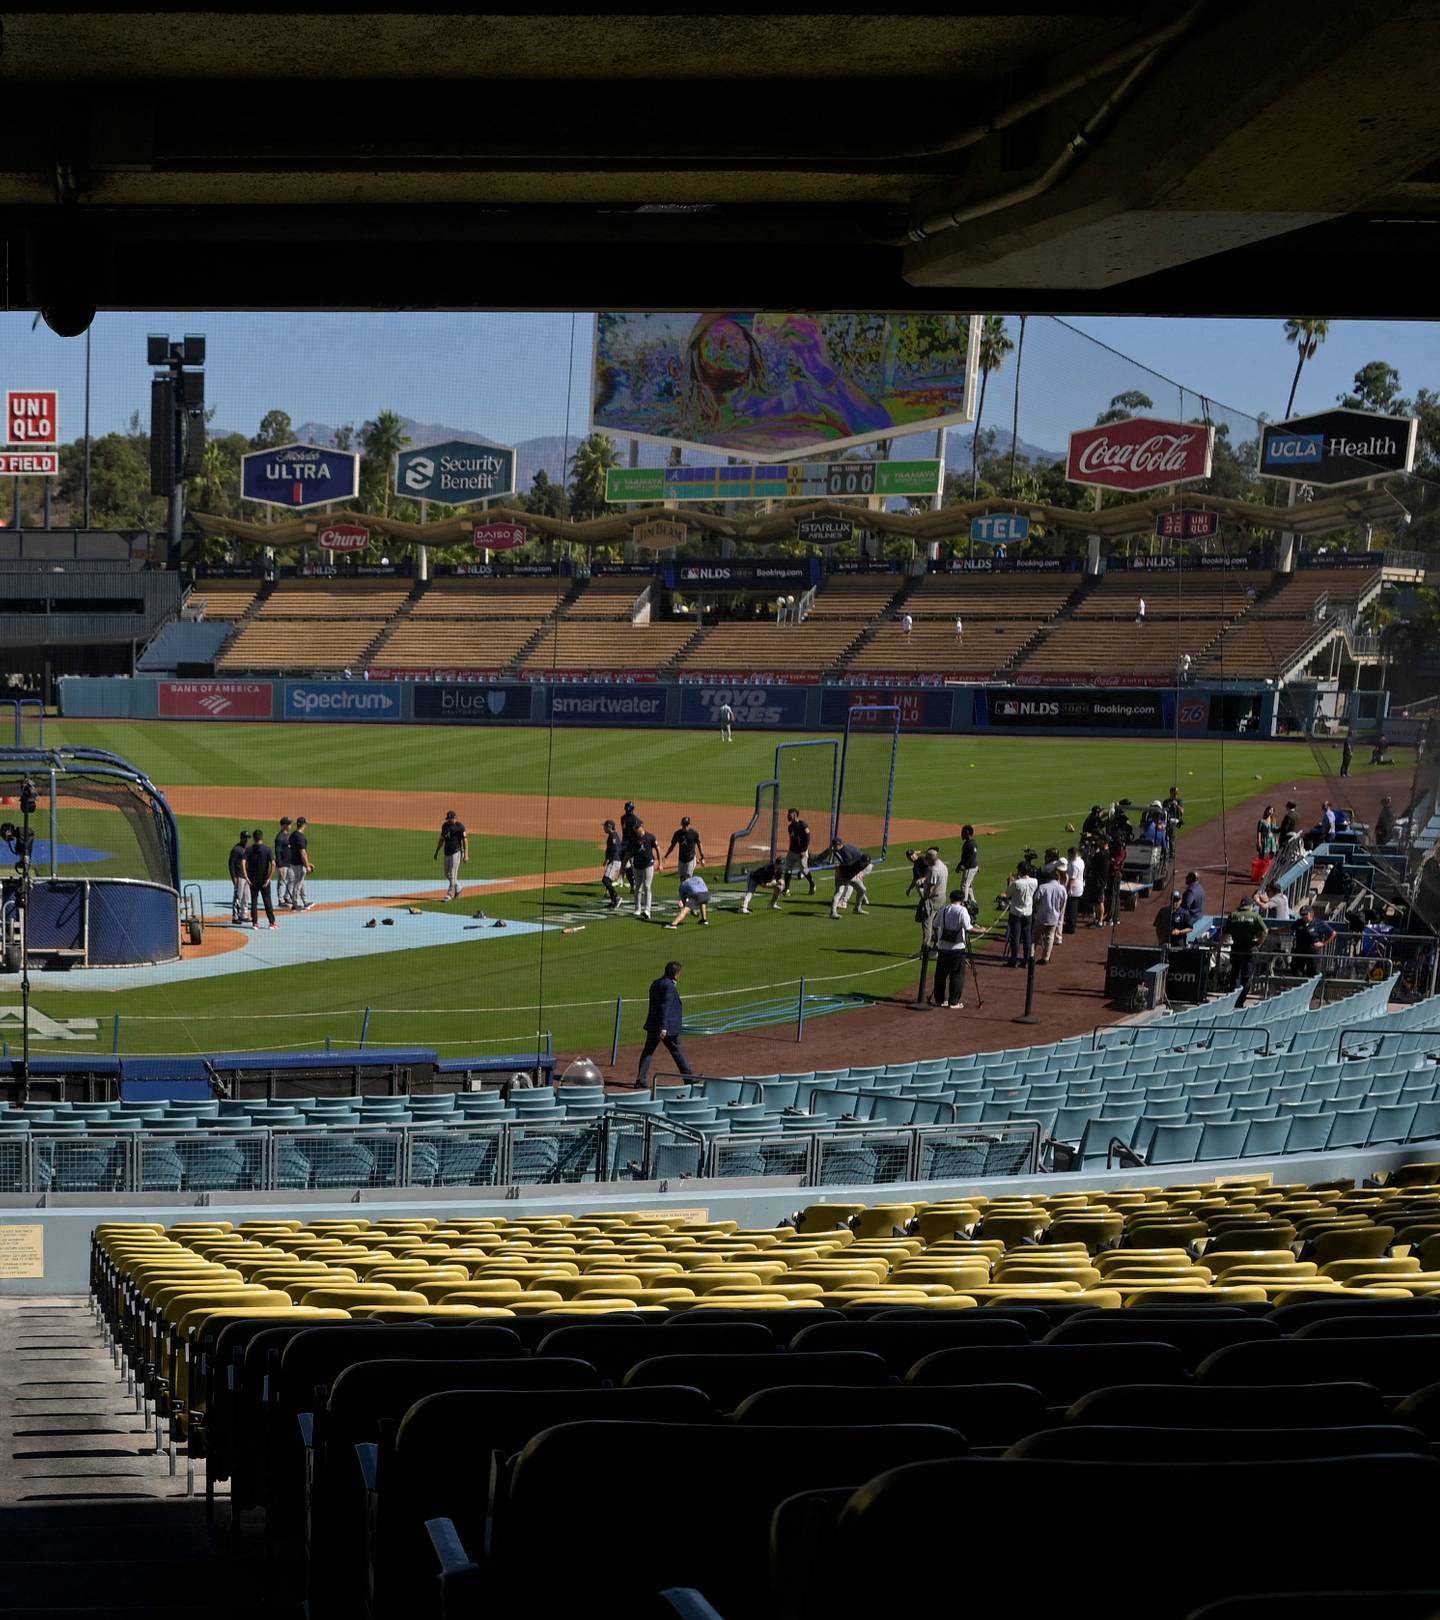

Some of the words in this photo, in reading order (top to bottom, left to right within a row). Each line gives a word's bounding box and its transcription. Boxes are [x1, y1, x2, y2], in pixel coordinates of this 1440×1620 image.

[13, 398, 48, 416] UNI
[13, 419, 51, 440] QLO
[1079, 433, 1197, 473] Coca-Cola
[1271, 441, 1316, 457] UCLA
[1328, 436, 1396, 457] Health
[9, 457, 51, 471] FIELD
[266, 464, 331, 480] ULTRA
[440, 456, 503, 474] Security
[440, 473, 494, 490] Benefit
[831, 474, 841, 493] 0
[846, 474, 856, 493] 0
[861, 473, 871, 492] 0
[801, 523, 849, 532] STARLUX
[978, 519, 1021, 538] TEL
[1192, 516, 1208, 525] UNI
[320, 530, 366, 546] Churu
[477, 530, 510, 538] DAISO
[467, 565, 492, 574] NLDS
[963, 559, 992, 569] NLDS
[1145, 557, 1176, 567] NLDS
[313, 566, 337, 575] NLDS
[700, 568, 730, 578] NLDS
[757, 568, 802, 577] Booking.com
[171, 685, 198, 693] BANK
[200, 685, 213, 693] OF
[215, 685, 260, 693] AMERICA
[293, 689, 387, 712] Spectrum
[442, 690, 485, 709] blue
[553, 696, 659, 713] smartwater
[700, 689, 767, 706] TOYO
[894, 696, 918, 707] UNI
[1020, 702, 1059, 715] NLDS
[1093, 704, 1155, 716] Booking.com
[1183, 706, 1202, 720] 76
